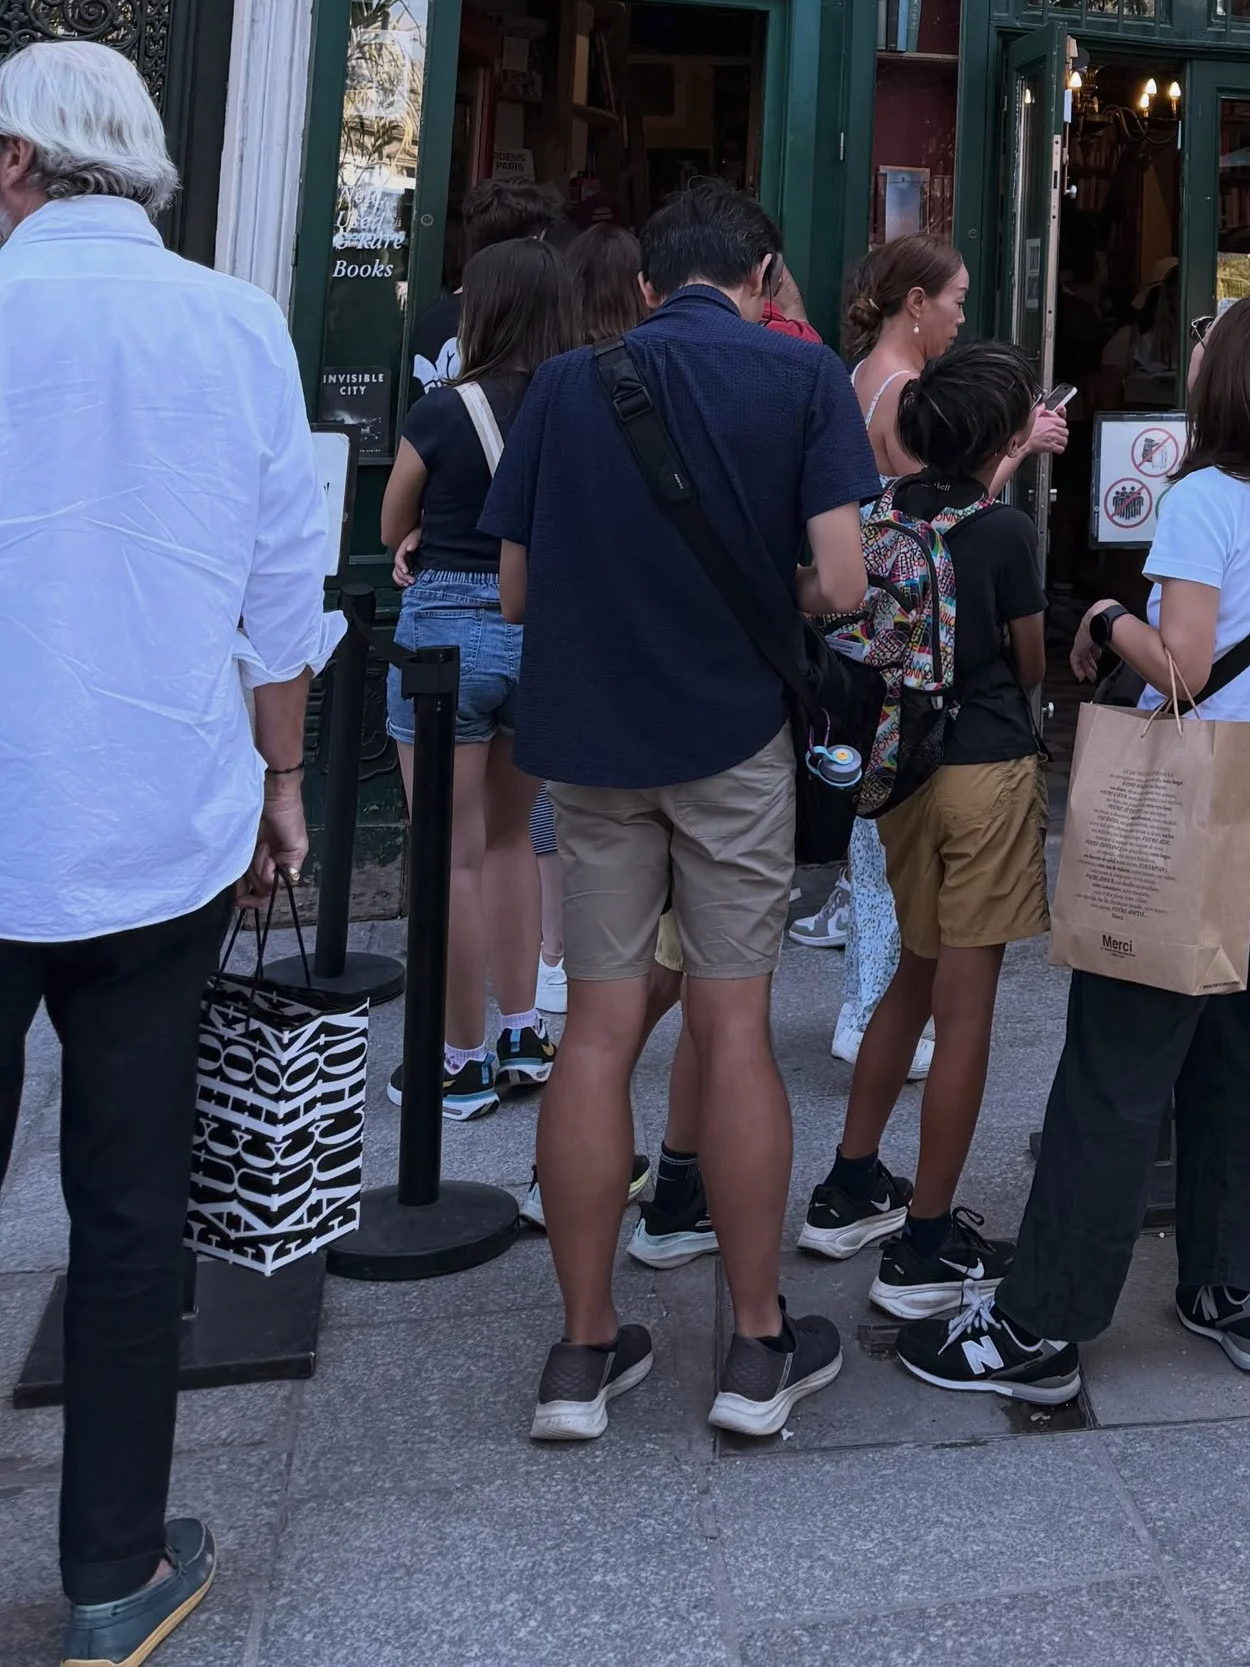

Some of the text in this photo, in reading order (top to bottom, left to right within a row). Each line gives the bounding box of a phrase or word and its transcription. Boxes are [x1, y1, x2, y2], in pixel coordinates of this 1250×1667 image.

[332, 258, 394, 278] Books
[322, 373, 385, 384] INVISIBLE
[339, 385, 367, 396] CITY
[1102, 934, 1133, 953] Merci
